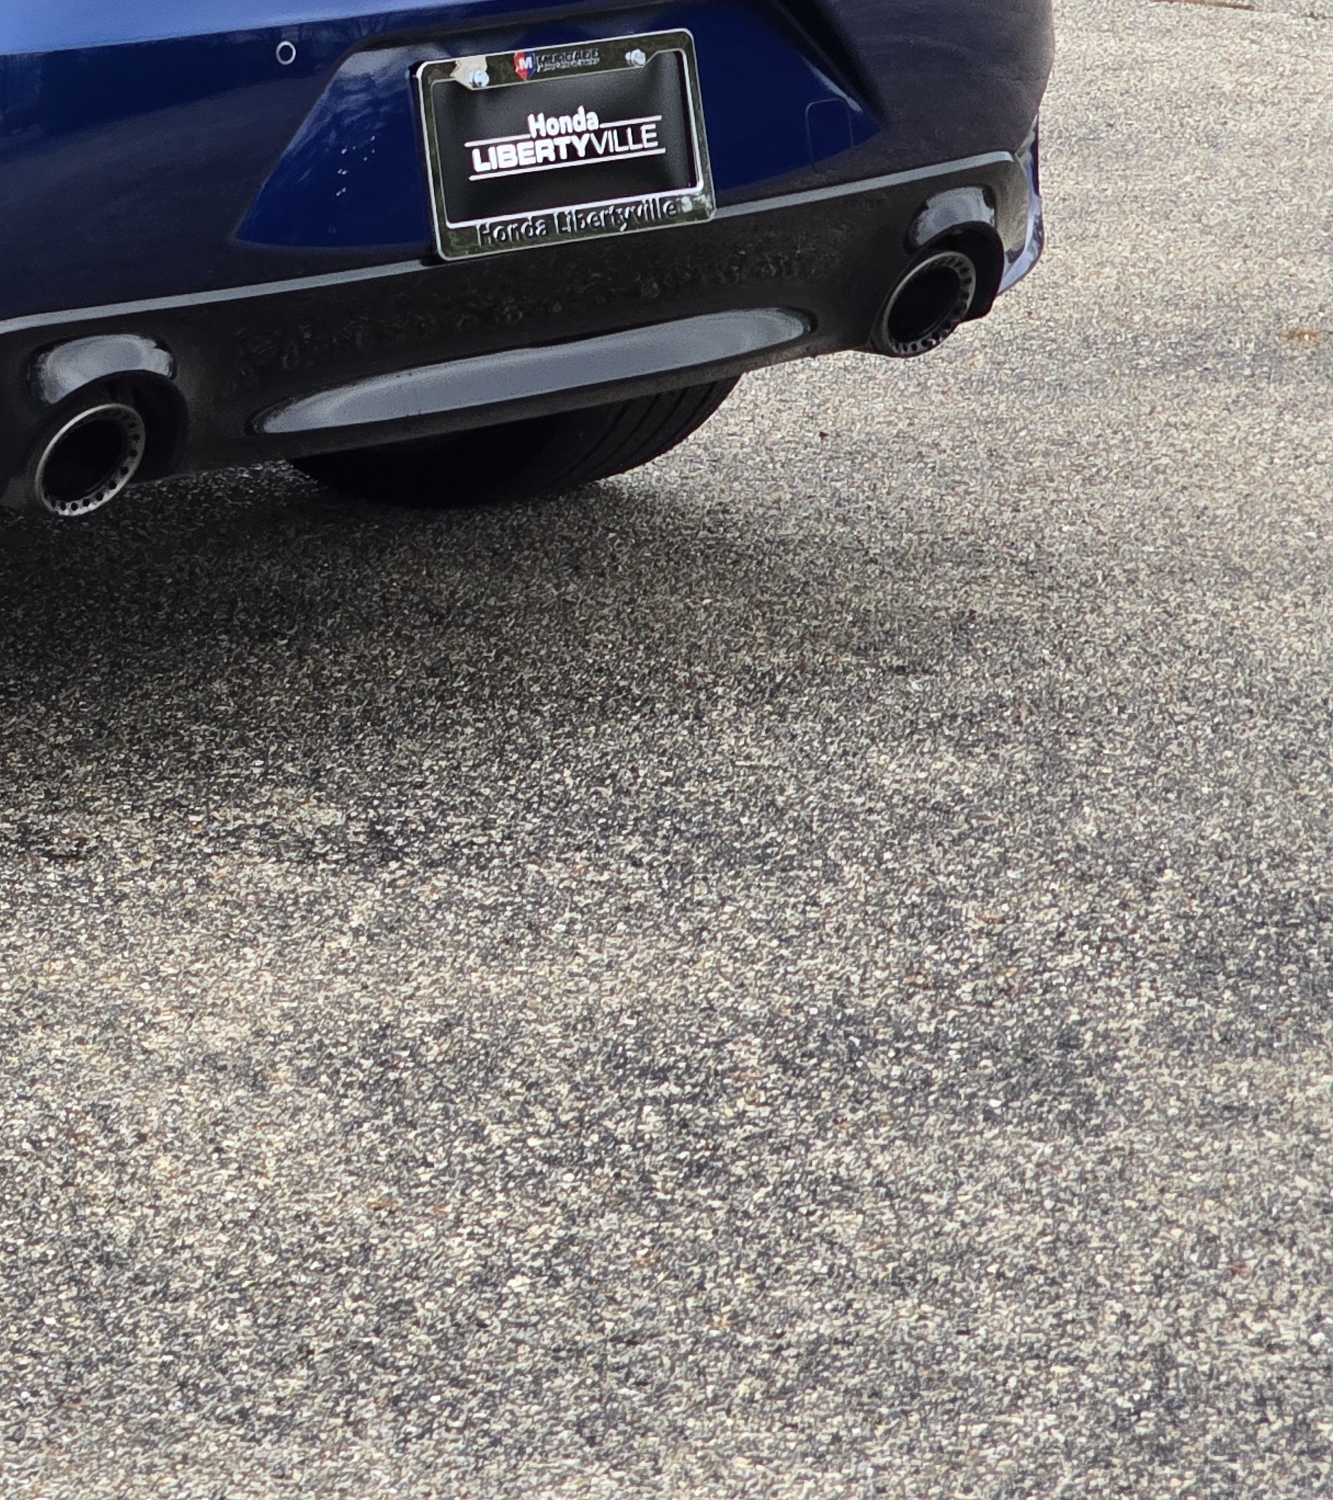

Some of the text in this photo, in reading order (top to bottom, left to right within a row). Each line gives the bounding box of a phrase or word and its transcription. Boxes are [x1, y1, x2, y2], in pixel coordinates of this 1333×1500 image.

[527, 104, 600, 138] Honda
[471, 123, 659, 173] LIBERTYVILLE
[475, 197, 678, 248] Honda Libertyville
